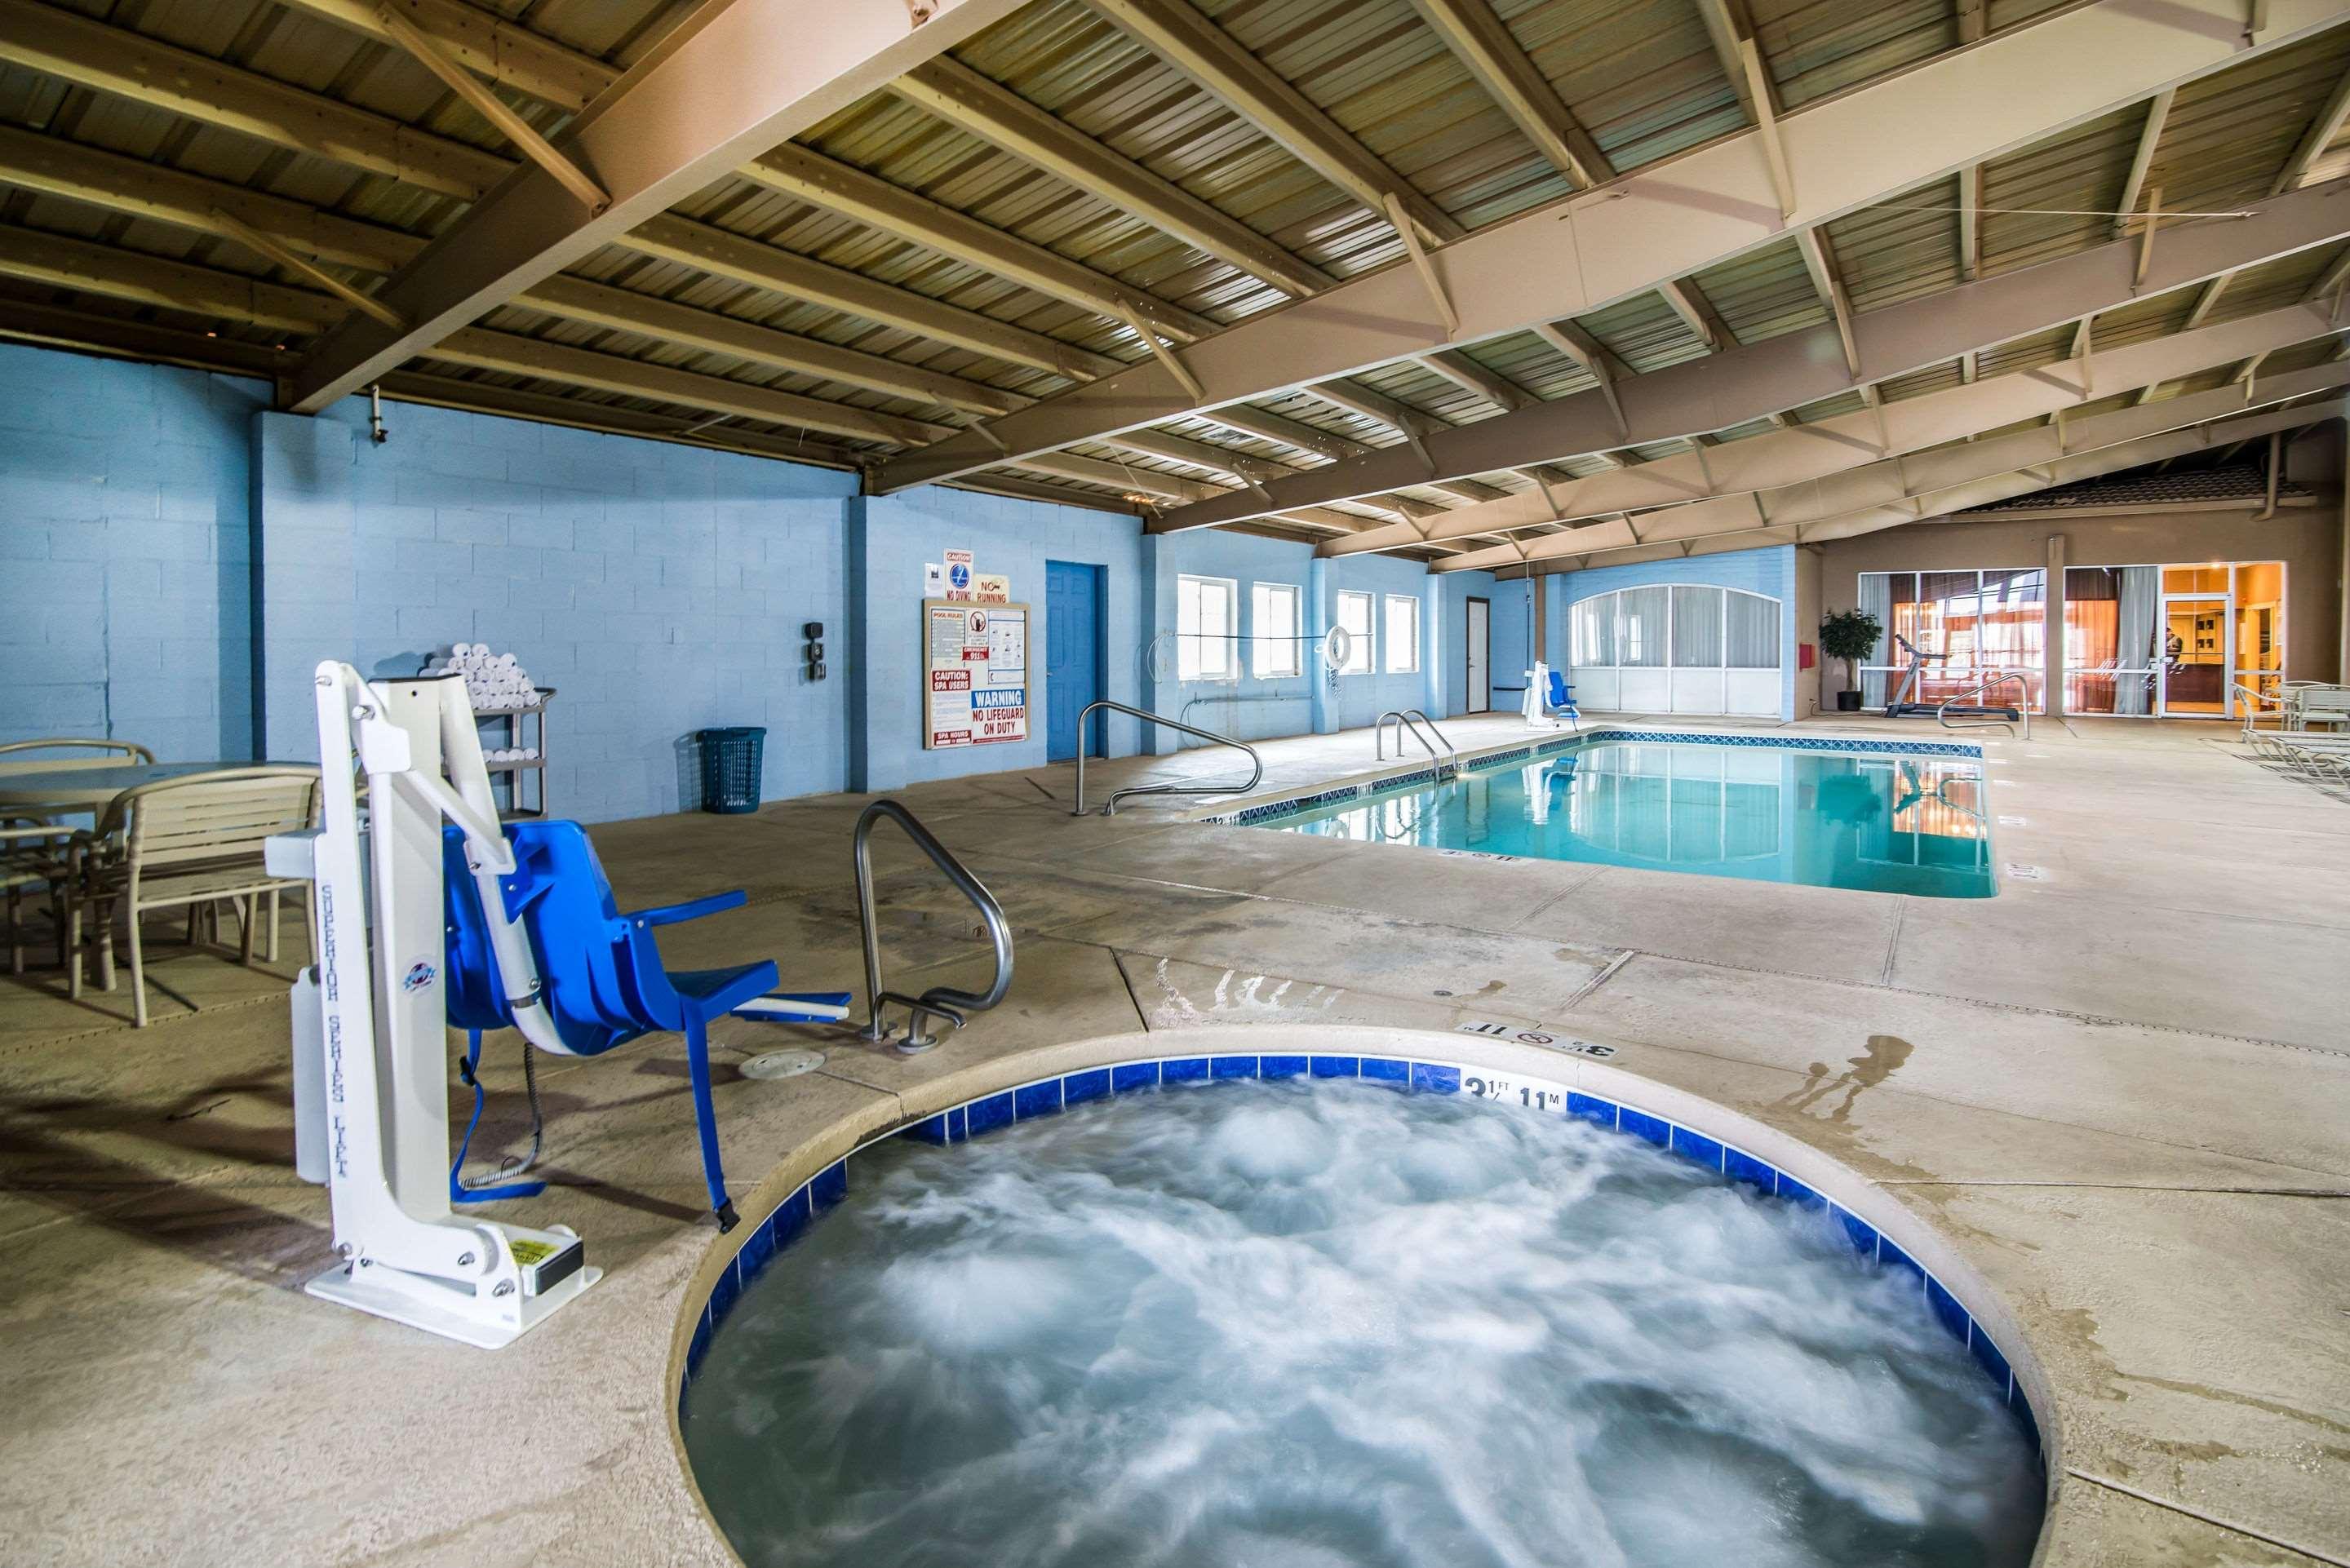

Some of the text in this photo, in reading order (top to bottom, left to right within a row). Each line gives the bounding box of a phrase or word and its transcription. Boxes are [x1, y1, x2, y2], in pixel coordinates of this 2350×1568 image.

[982, 582, 995, 591] NO
[947, 591, 954, 600] NO
[977, 592, 1006, 604] RUNNING
[934, 680, 969, 690] SPA USERS
[975, 691, 1022, 706] WARNING
[973, 707, 1024, 722] NO LIFEGUARD
[984, 721, 1016, 735] ON DUTY
